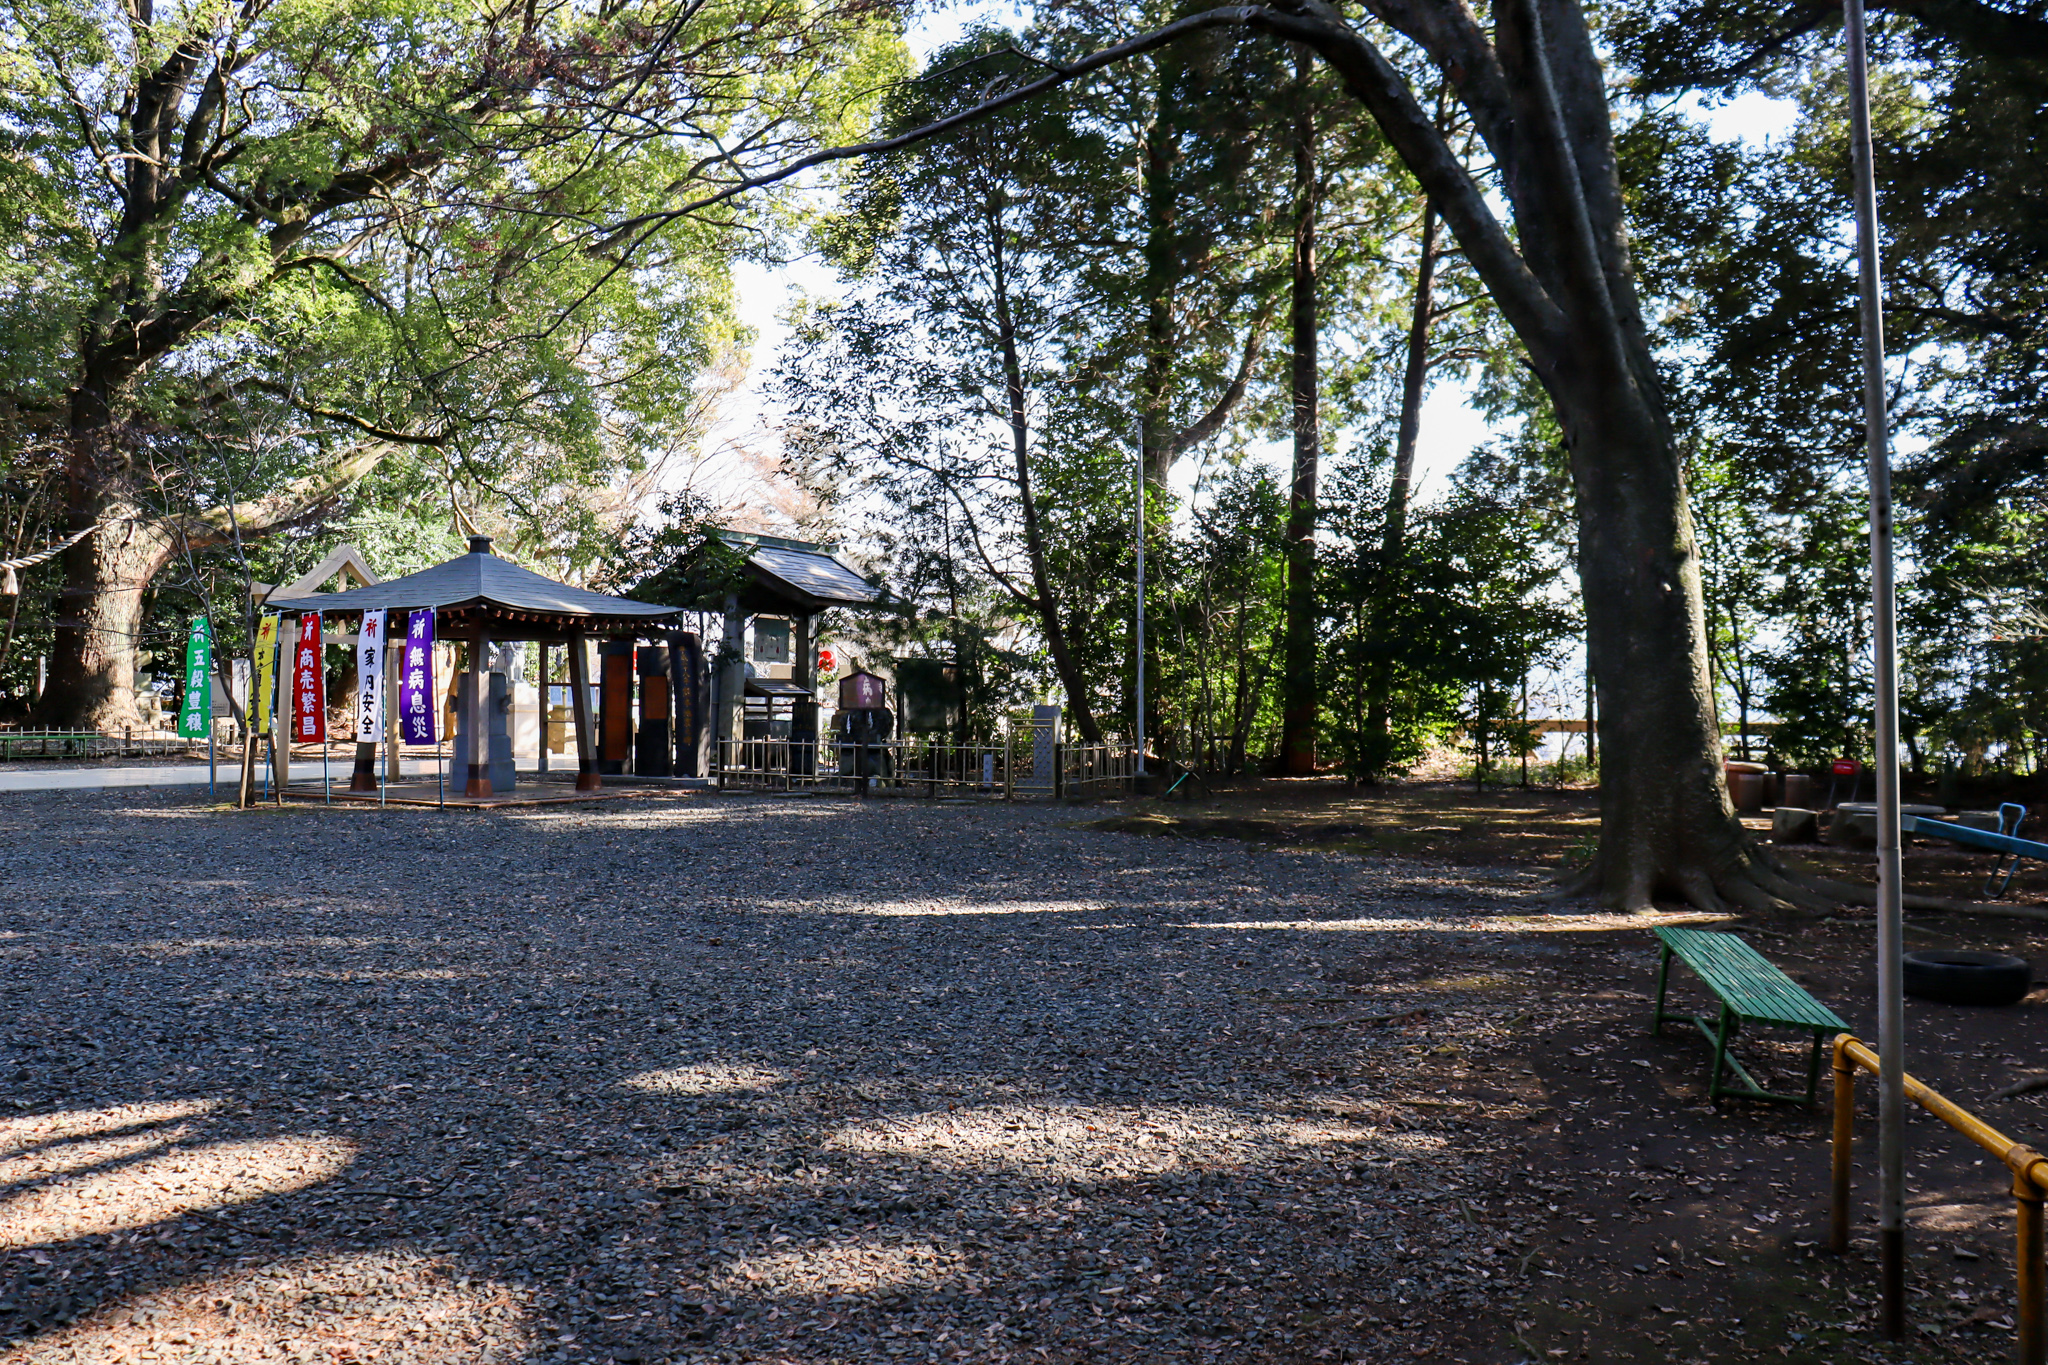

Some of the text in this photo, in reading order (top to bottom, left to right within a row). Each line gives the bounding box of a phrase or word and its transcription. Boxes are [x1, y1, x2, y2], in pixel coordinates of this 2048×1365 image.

[364, 618, 378, 639] 祈
[299, 647, 317, 736] 商売繁昌
[407, 617, 429, 739] 祈 無病息災
